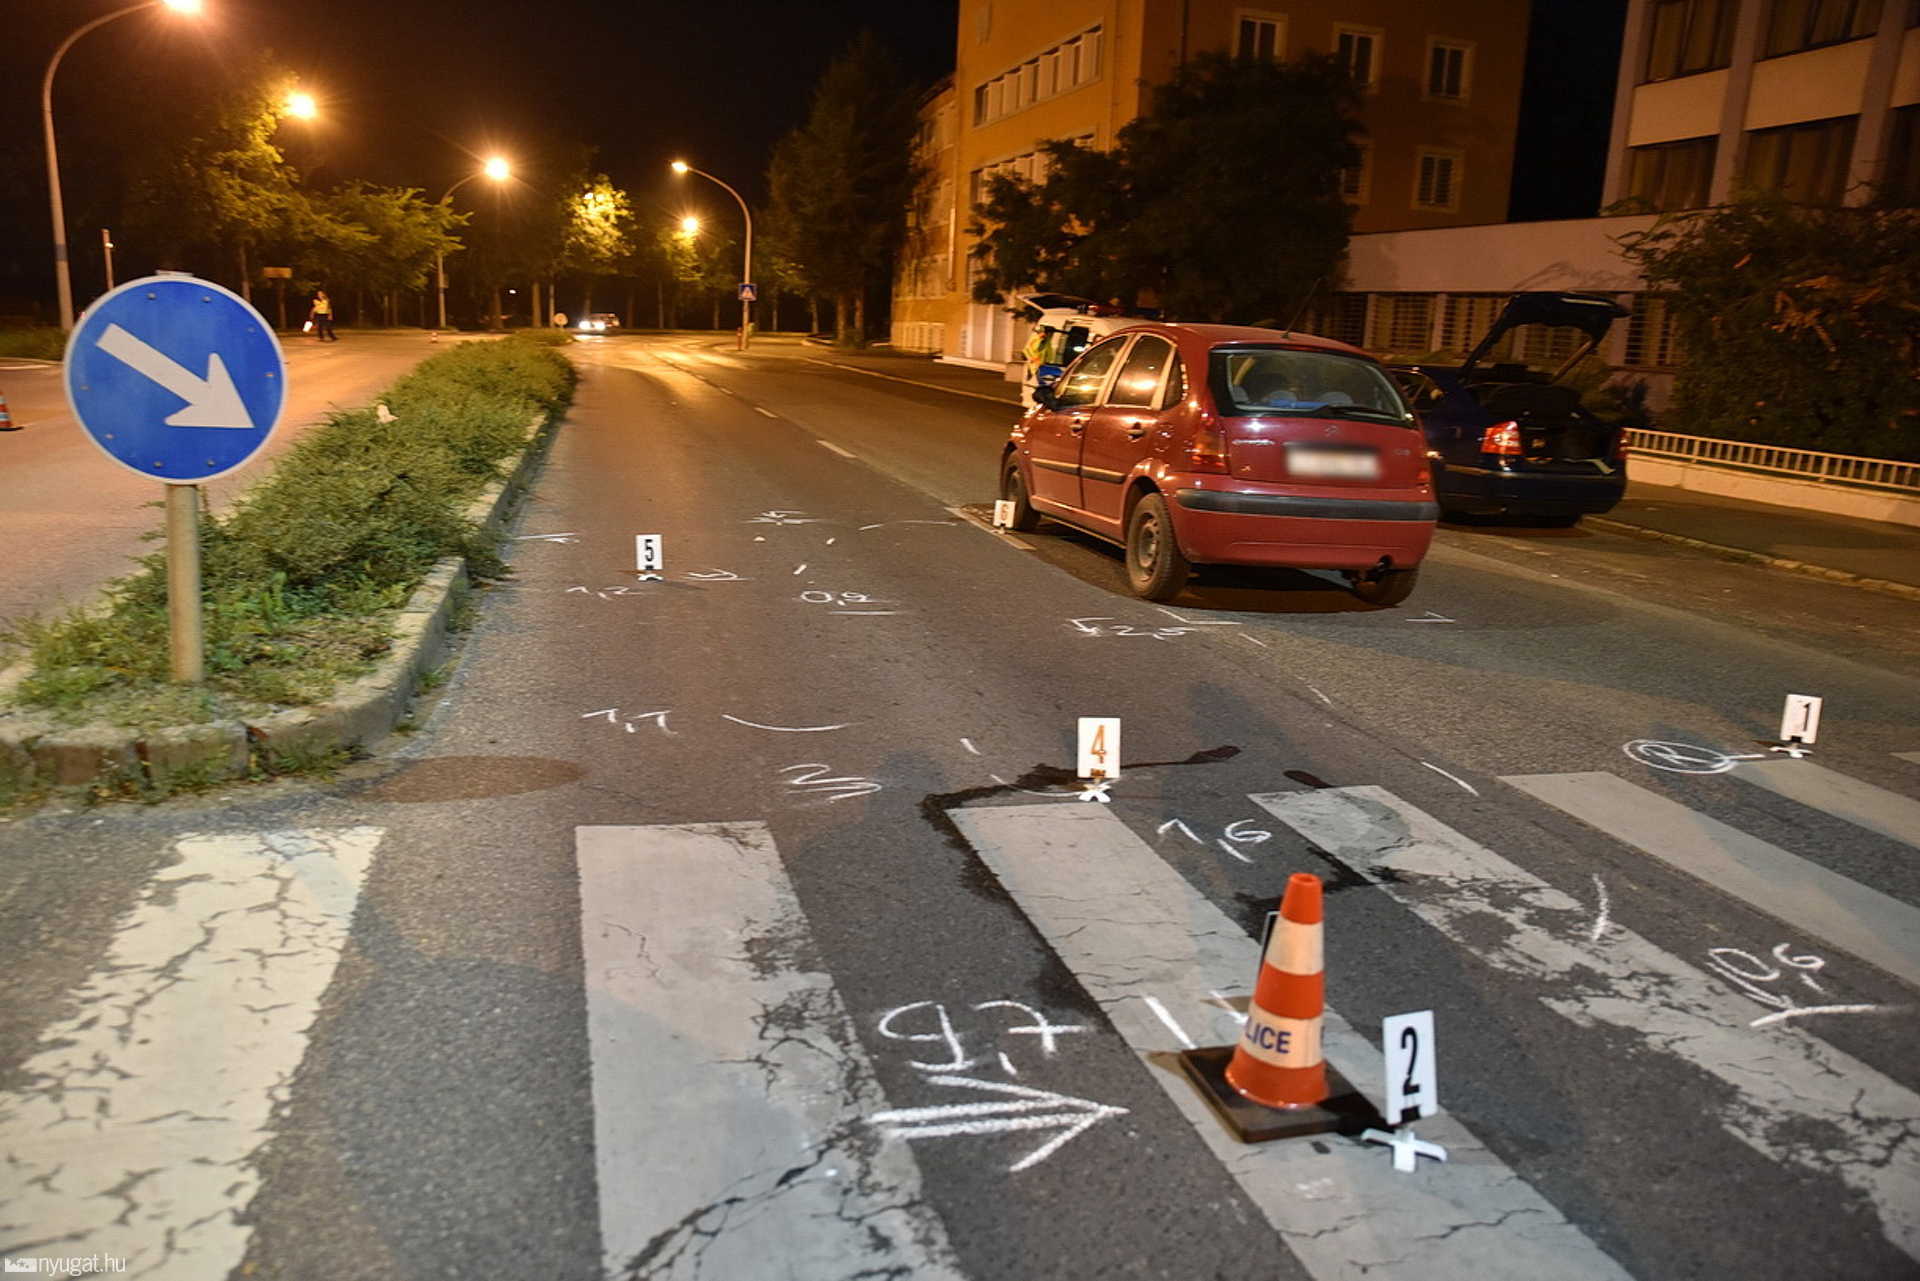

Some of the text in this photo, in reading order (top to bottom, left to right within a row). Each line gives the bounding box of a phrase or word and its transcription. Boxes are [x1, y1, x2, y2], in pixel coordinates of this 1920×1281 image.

[644, 538, 654, 562] 5
[1802, 702, 1812, 732] 1
[1090, 724, 1108, 764] 4
[1401, 1026, 1421, 1096] 2
